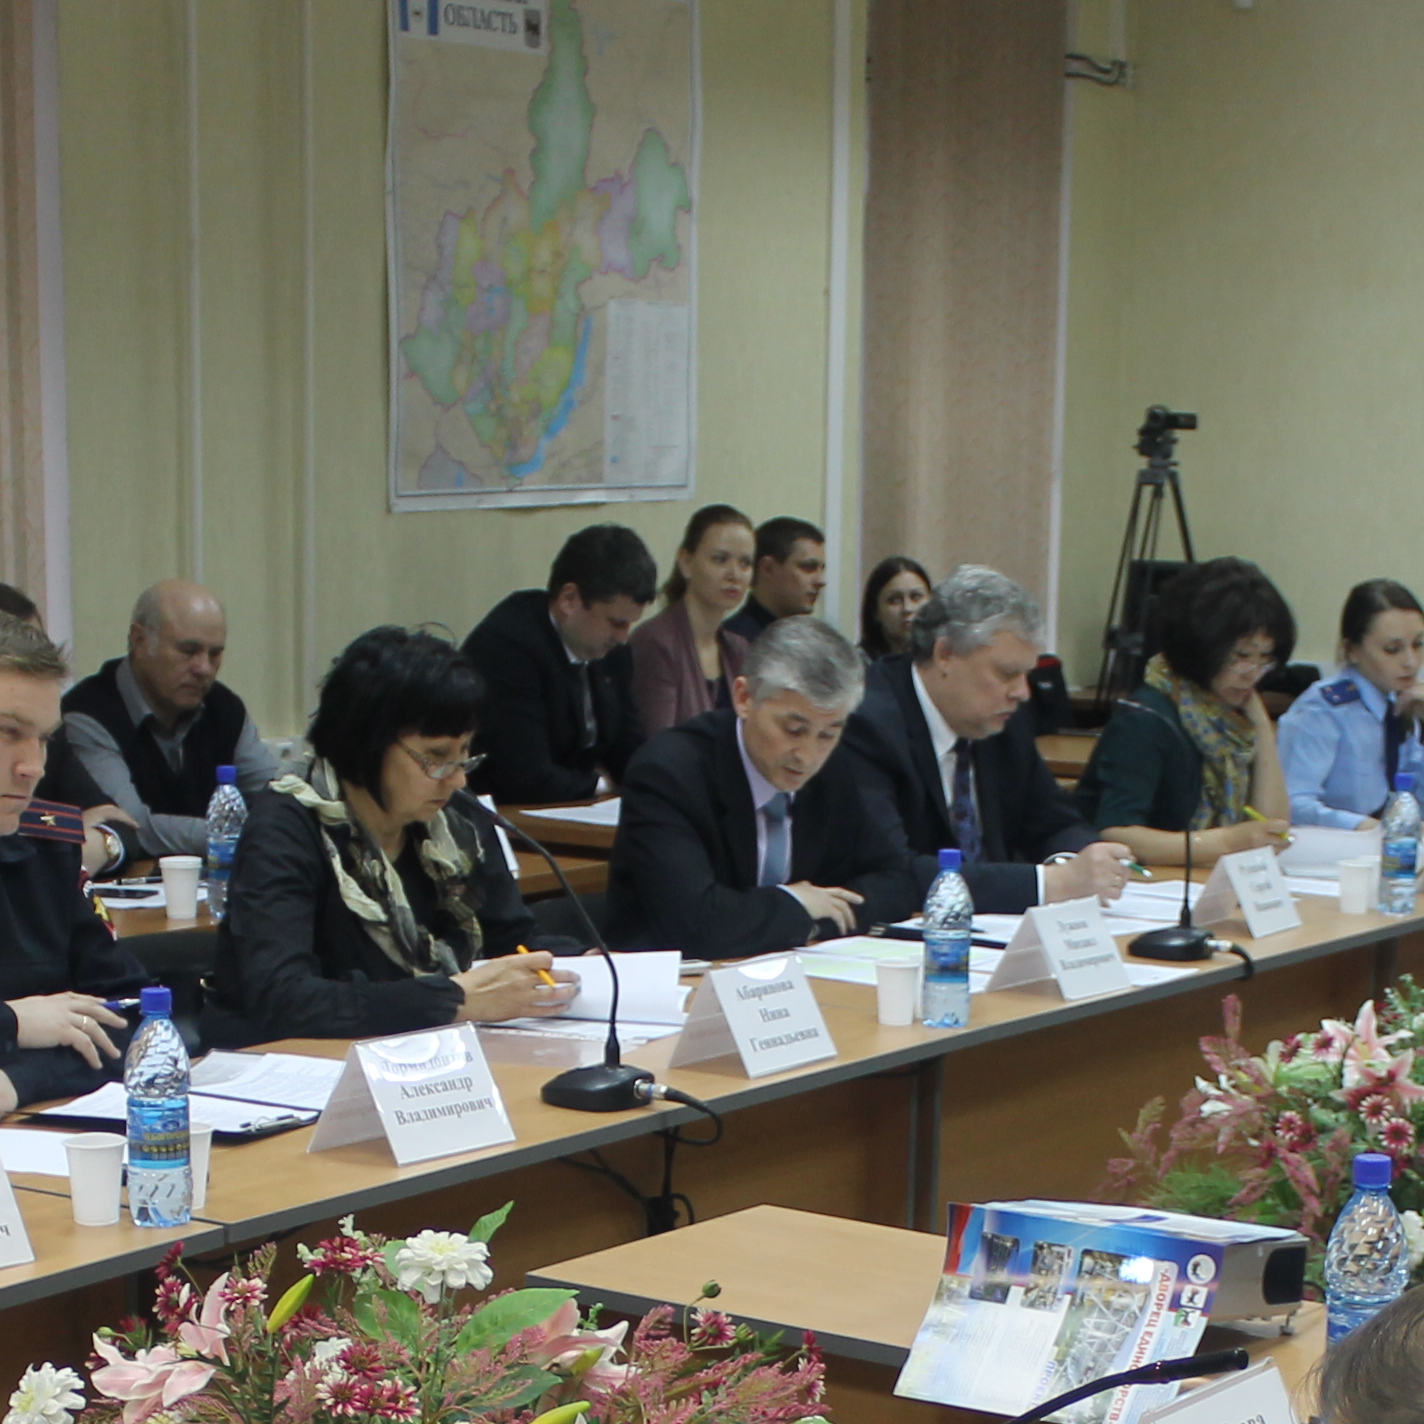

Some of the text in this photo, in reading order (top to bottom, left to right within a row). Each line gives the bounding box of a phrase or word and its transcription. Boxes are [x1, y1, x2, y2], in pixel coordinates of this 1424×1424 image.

[445, 4, 518, 34] ОБЛАСТЬ
[758, 1007, 791, 1023] Нина
[381, 1051, 474, 1078] Дормидонтв
[400, 1075, 474, 1100] Александр
[394, 1097, 494, 1126] Владимирович
